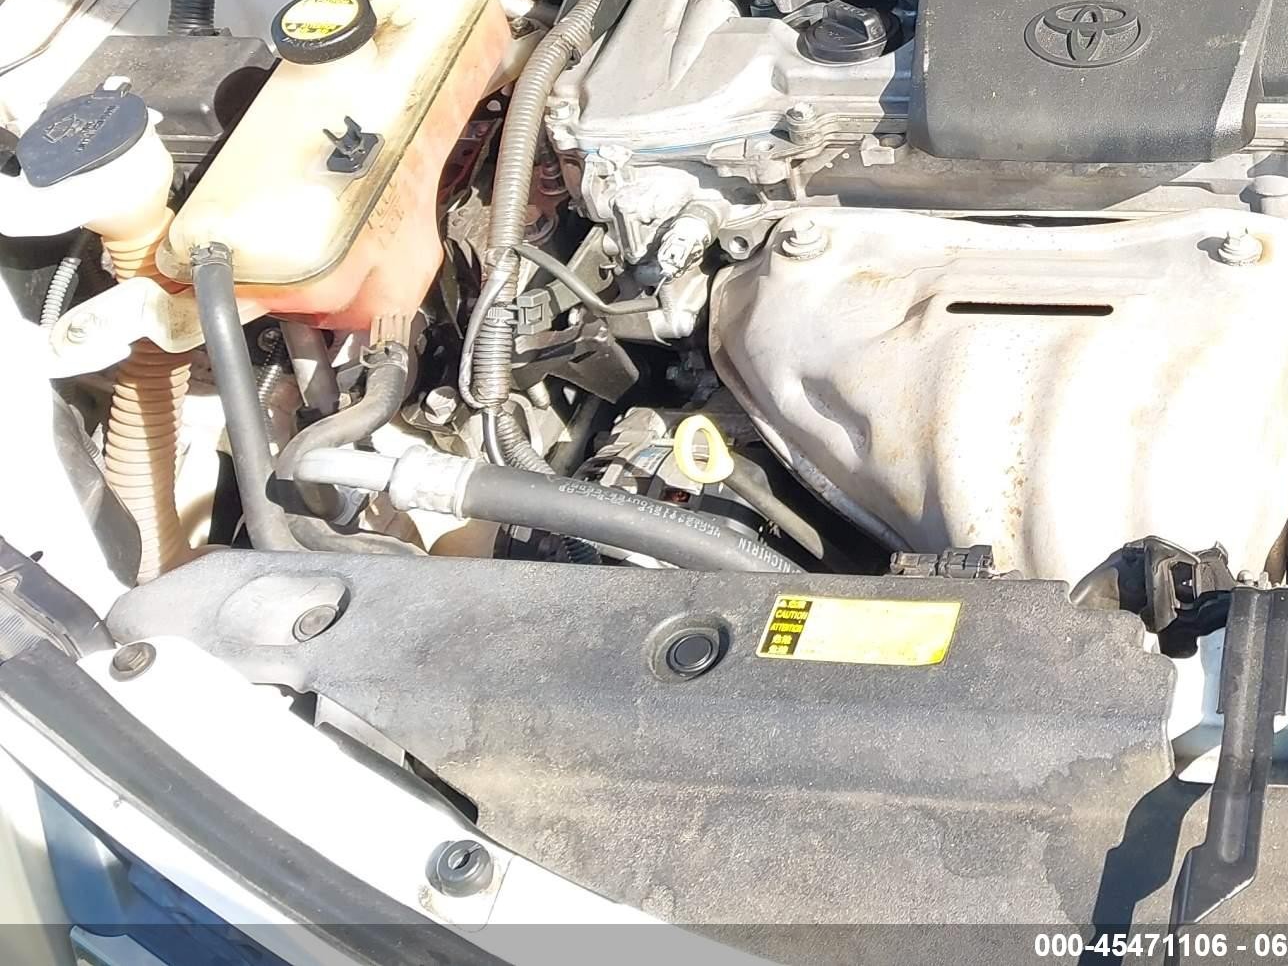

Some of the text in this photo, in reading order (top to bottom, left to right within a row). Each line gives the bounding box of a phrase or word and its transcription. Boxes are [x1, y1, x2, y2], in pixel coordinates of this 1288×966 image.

[738, 536, 792, 573] NICHIRIN
[775, 608, 809, 620] CAUTION
[769, 622, 804, 633] ATTENTION
